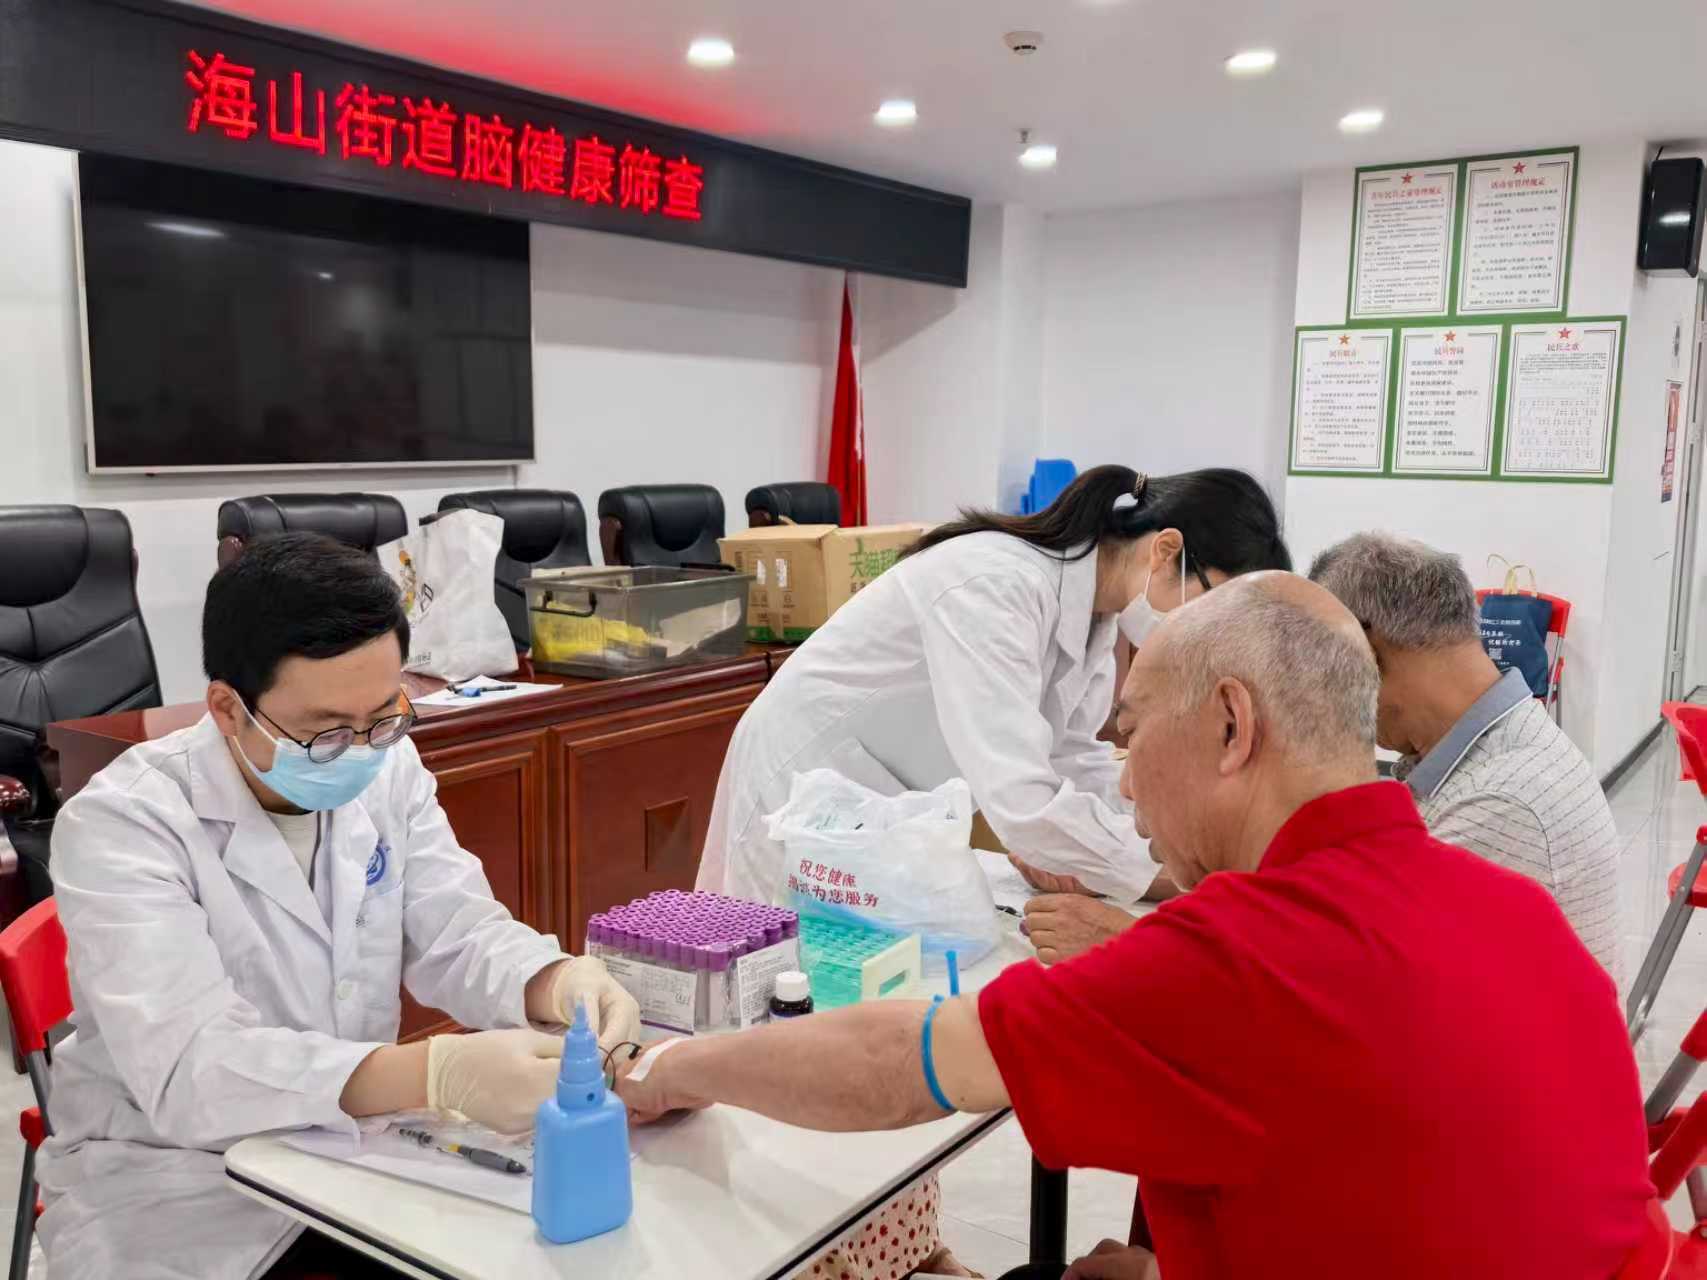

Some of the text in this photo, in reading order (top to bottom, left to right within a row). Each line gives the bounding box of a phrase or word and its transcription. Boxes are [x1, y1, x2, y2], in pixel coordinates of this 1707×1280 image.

[184, 48, 705, 221] 海山街道脑健康筛查
[799, 858, 857, 888] 祝您健康
